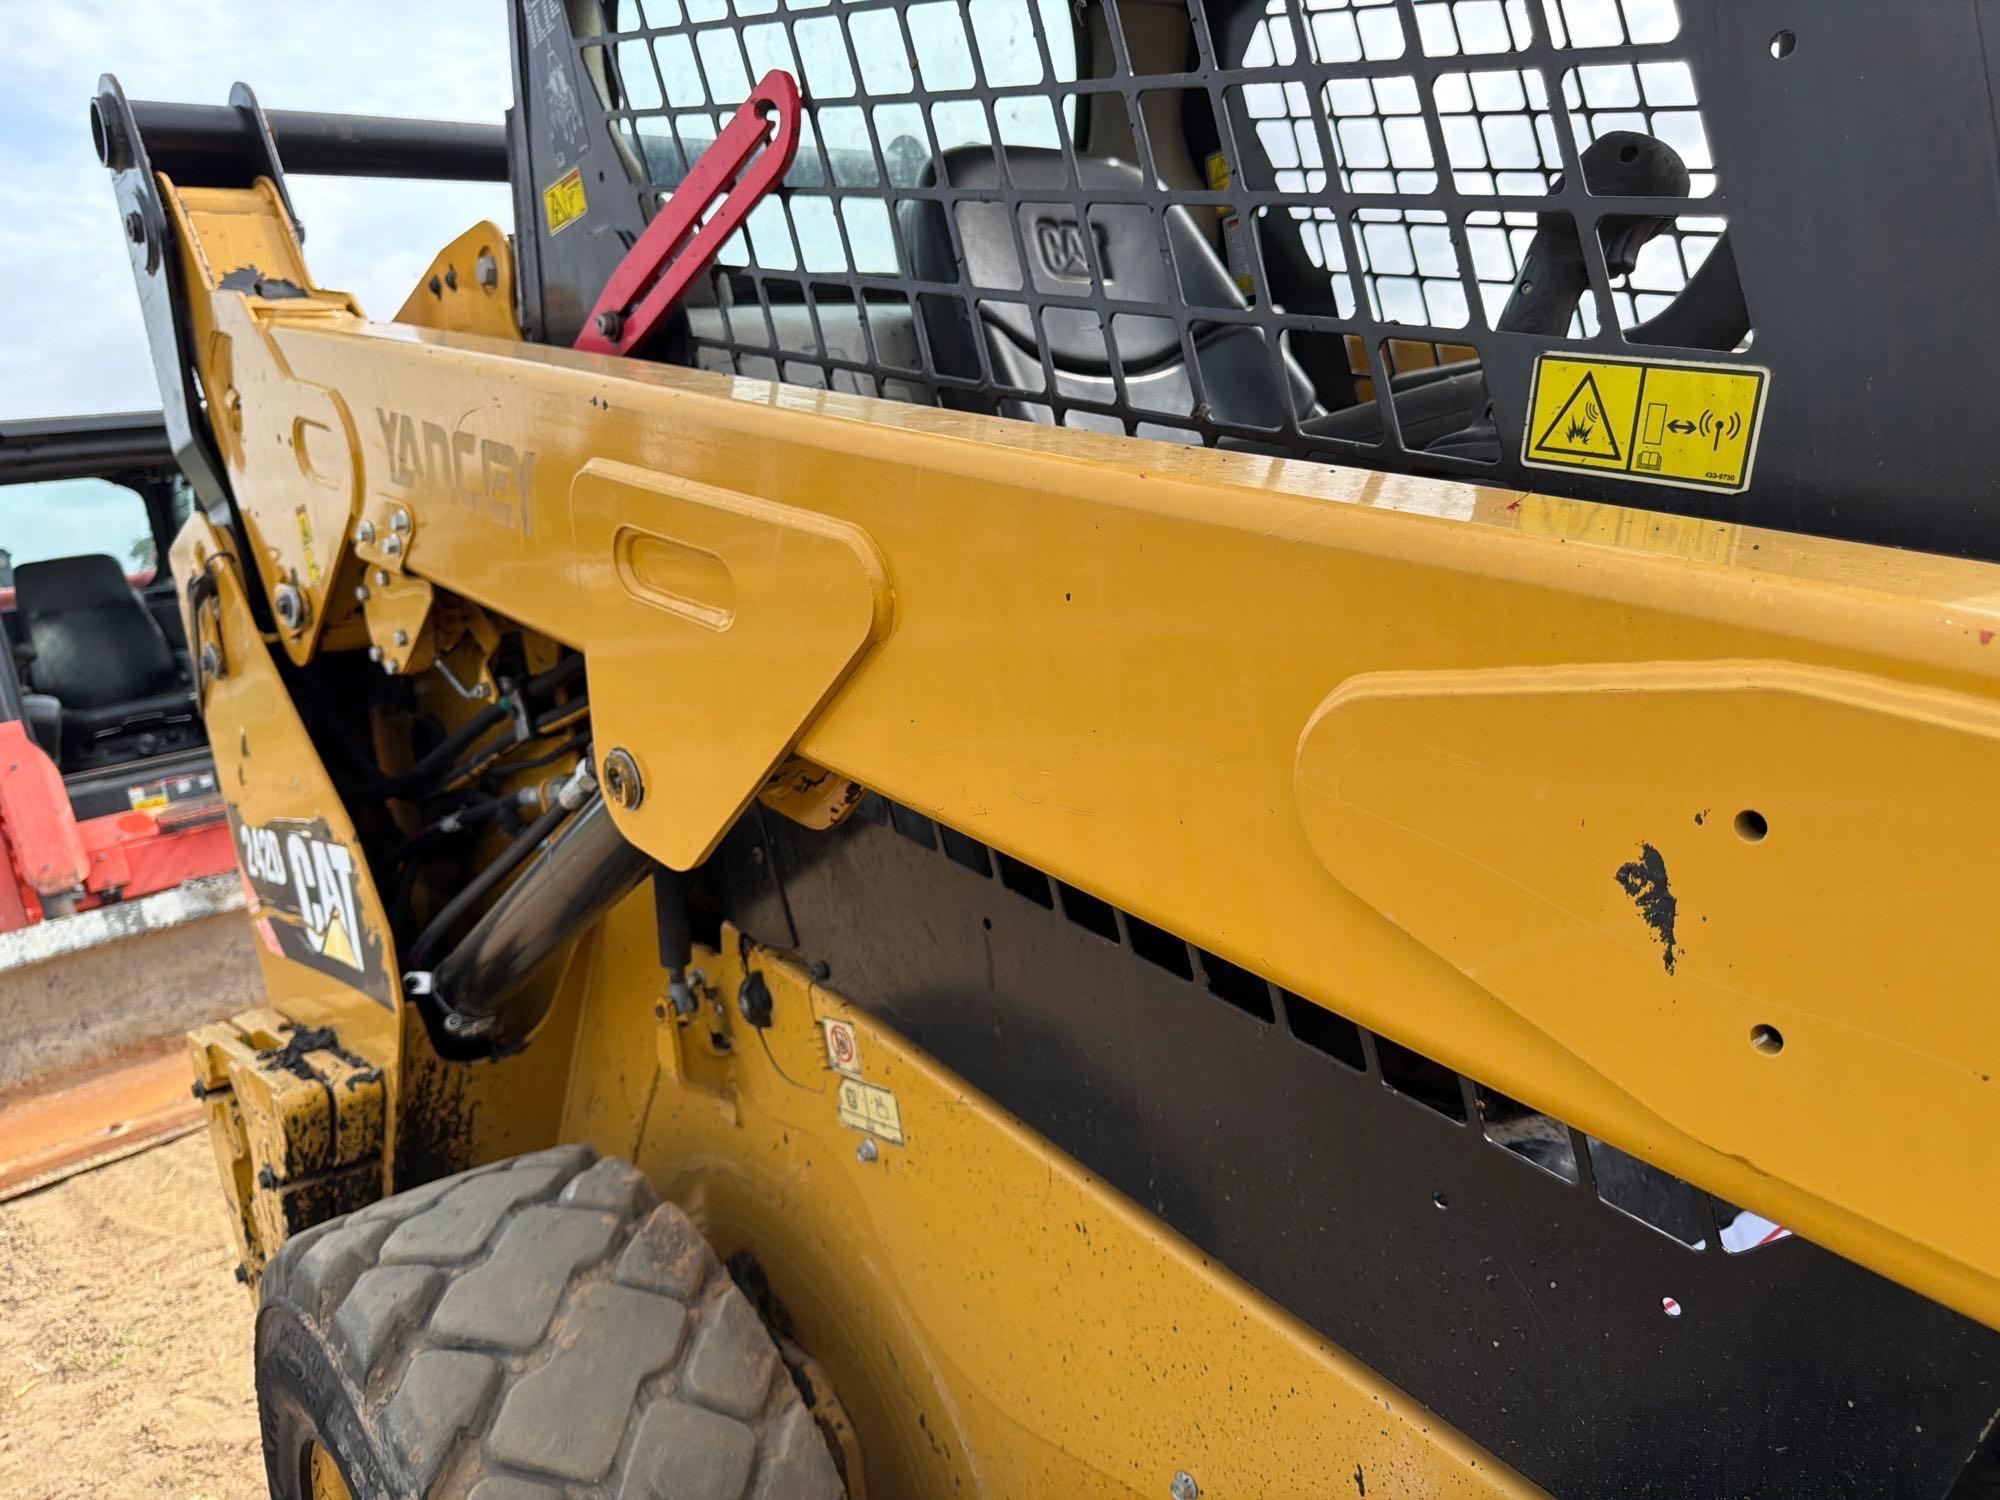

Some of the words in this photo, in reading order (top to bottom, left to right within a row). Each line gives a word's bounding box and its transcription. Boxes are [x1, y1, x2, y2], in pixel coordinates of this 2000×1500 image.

[375, 406, 536, 538] YANCEY
[1704, 471, 1737, 482] 433-9730
[240, 823, 288, 886] 242D
[287, 831, 365, 974] CAT
